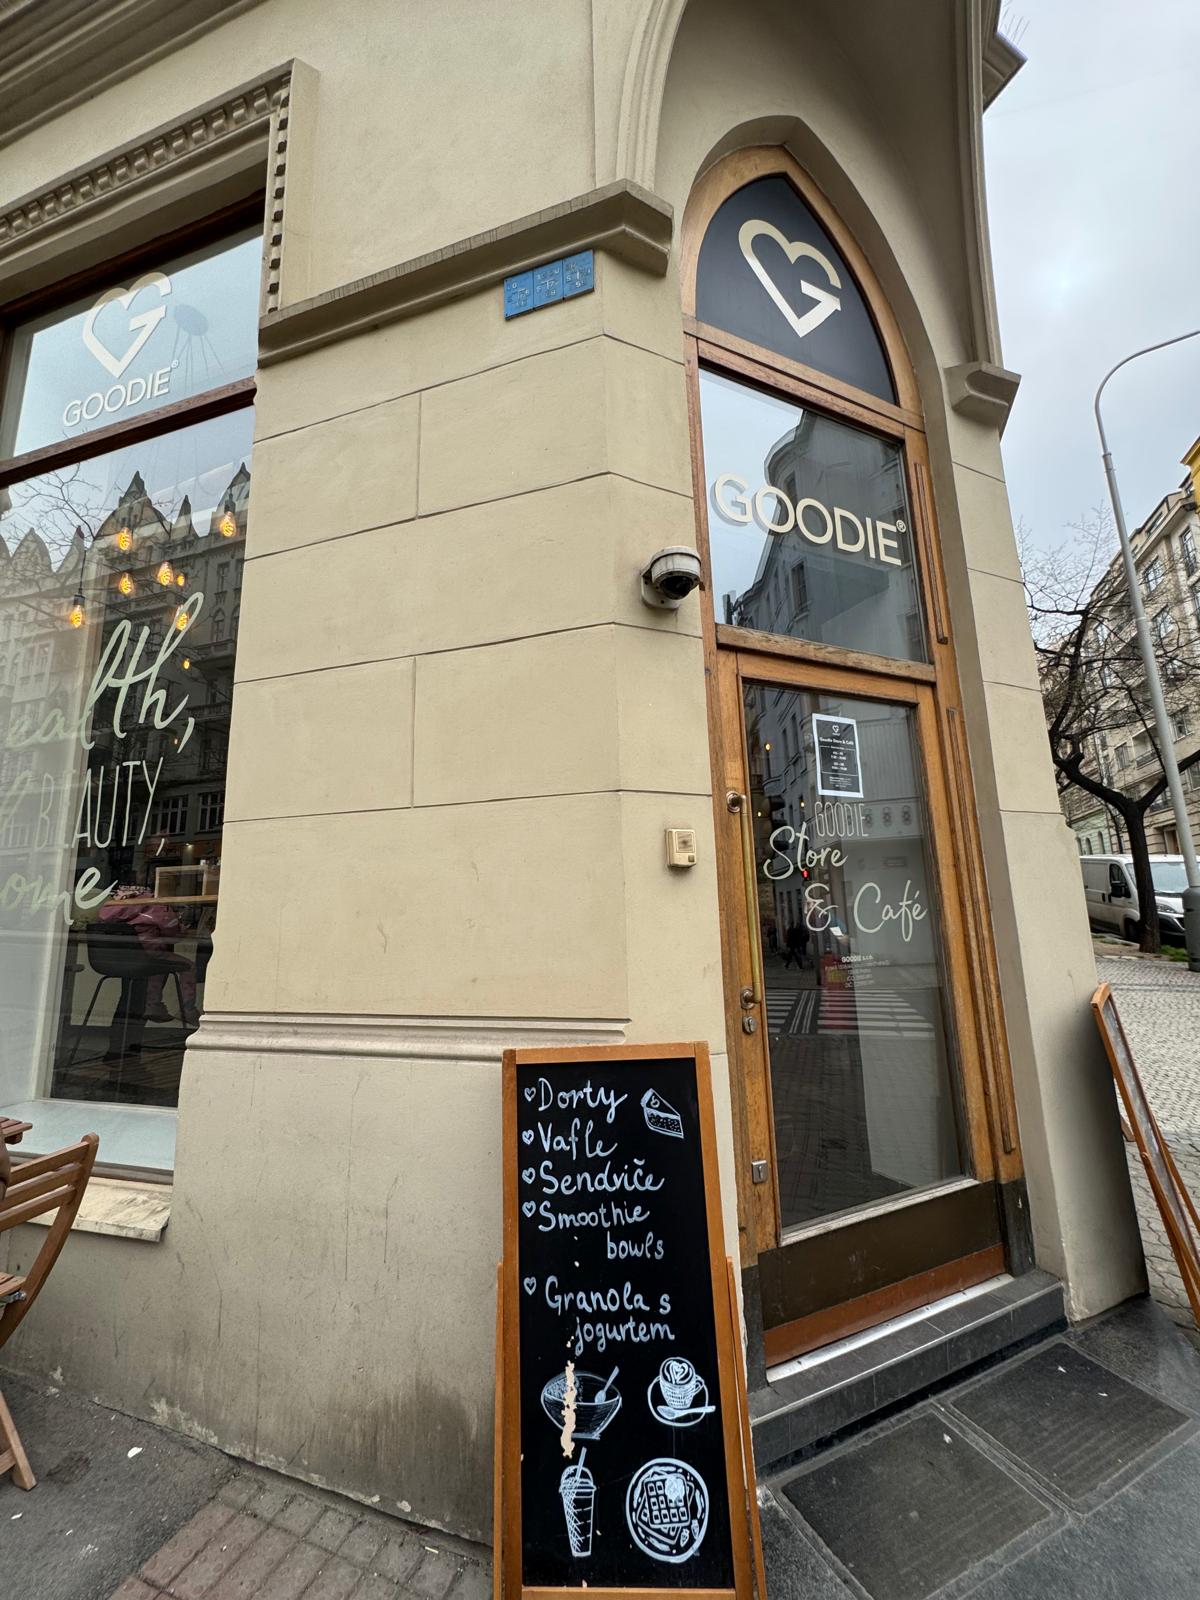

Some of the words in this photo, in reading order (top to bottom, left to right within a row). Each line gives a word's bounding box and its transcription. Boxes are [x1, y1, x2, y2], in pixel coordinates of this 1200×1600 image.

[7, 591, 204, 753] ealth,
[815, 802, 869, 837] GOODIE
[763, 822, 848, 880] Store
[804, 883, 839, 931] &
[854, 880, 928, 942] Café
[538, 1077, 628, 1123] Dorty
[537, 1117, 618, 1160] Vafle
[539, 1158, 665, 1195] Sendviče
[538, 1200, 650, 1232] Smoothie
[606, 1231, 665, 1260] bowls
[545, 1275, 650, 1316] Granola
[659, 1293, 672, 1315] s
[574, 1316, 675, 1357] jogurtem
